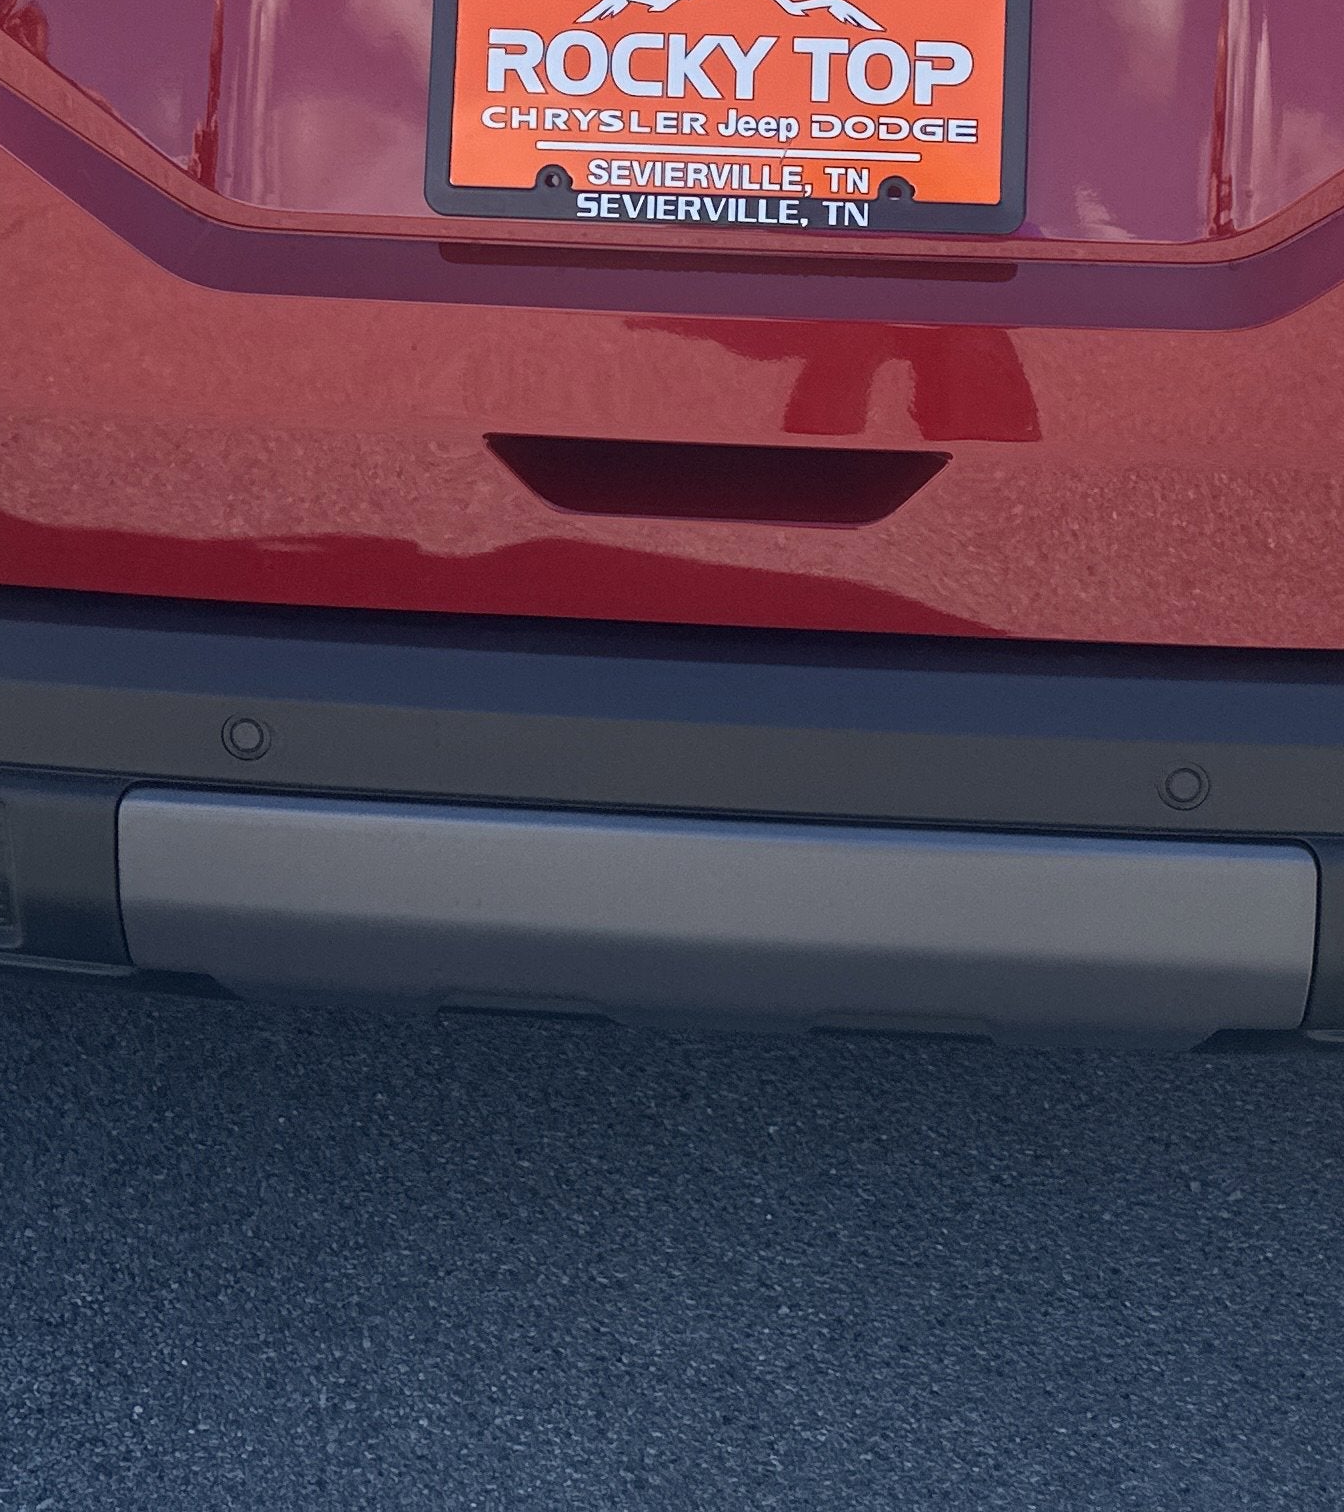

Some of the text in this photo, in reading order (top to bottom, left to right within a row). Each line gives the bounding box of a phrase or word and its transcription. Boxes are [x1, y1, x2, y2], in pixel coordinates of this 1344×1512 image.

[487, 27, 974, 107] ROCKY TOP
[481, 105, 979, 144] CHRYSLER Jeep DODGE
[587, 160, 870, 197] SEVIERVILLE, TN
[576, 193, 870, 228] SEVIERVILLE, TN
